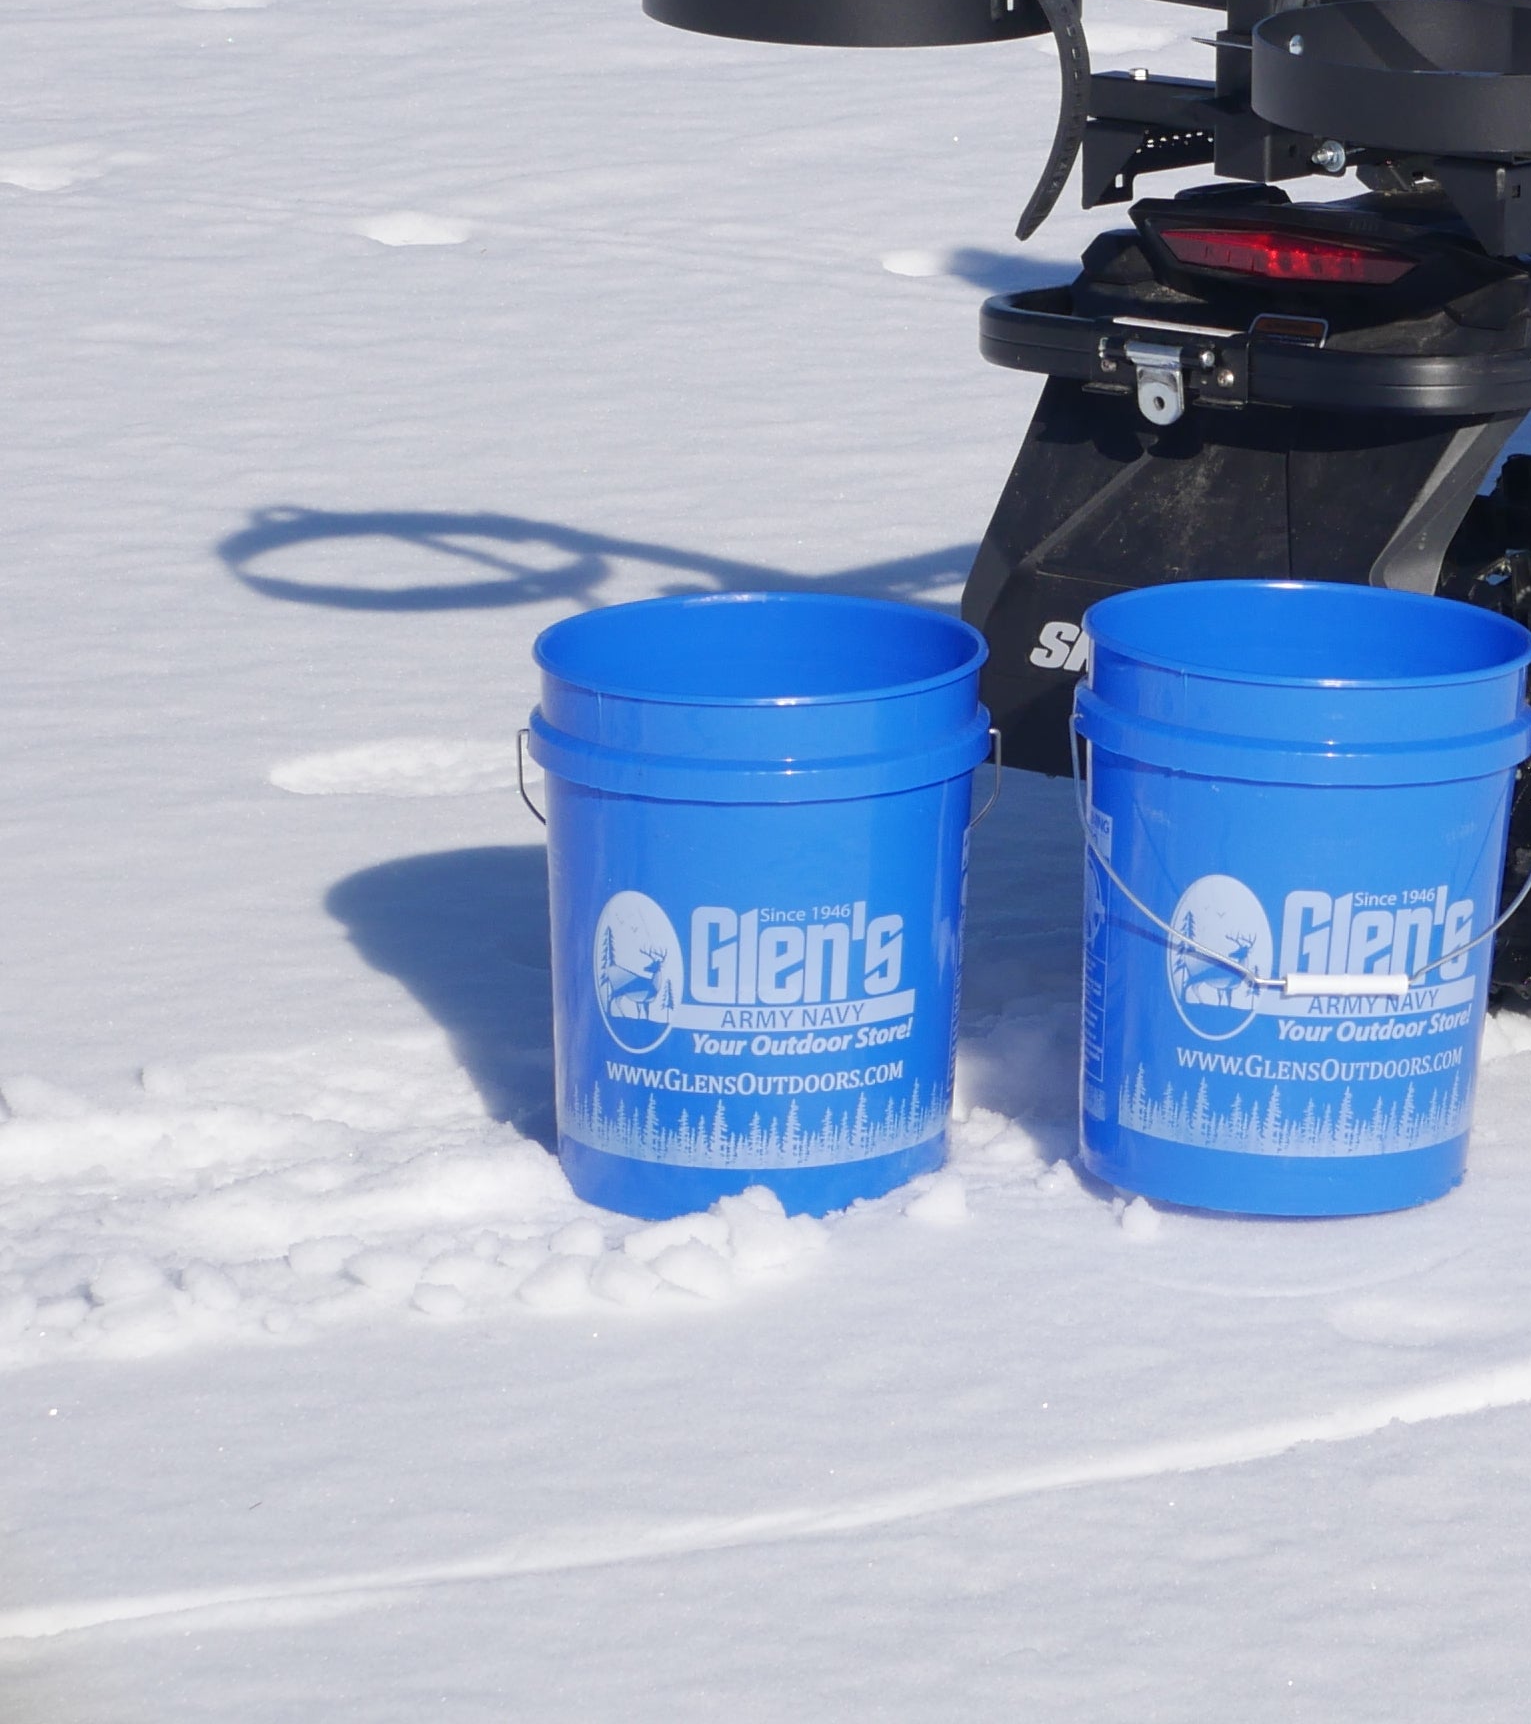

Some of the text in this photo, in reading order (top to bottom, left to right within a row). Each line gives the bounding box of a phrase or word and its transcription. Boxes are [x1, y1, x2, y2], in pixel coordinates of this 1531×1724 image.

[760, 903, 851, 923] Since 1946
[1354, 887, 1435, 907] Since 1946
[1279, 885, 1475, 987] Glen's
[690, 900, 904, 1006] Glen's
[720, 1003, 865, 1029] ARMY NAVY
[1308, 988, 1439, 1015] ARMY NAVY
[692, 1016, 914, 1056] Your Outdoor Store!
[1278, 1003, 1470, 1043] Your Outdoor Store!
